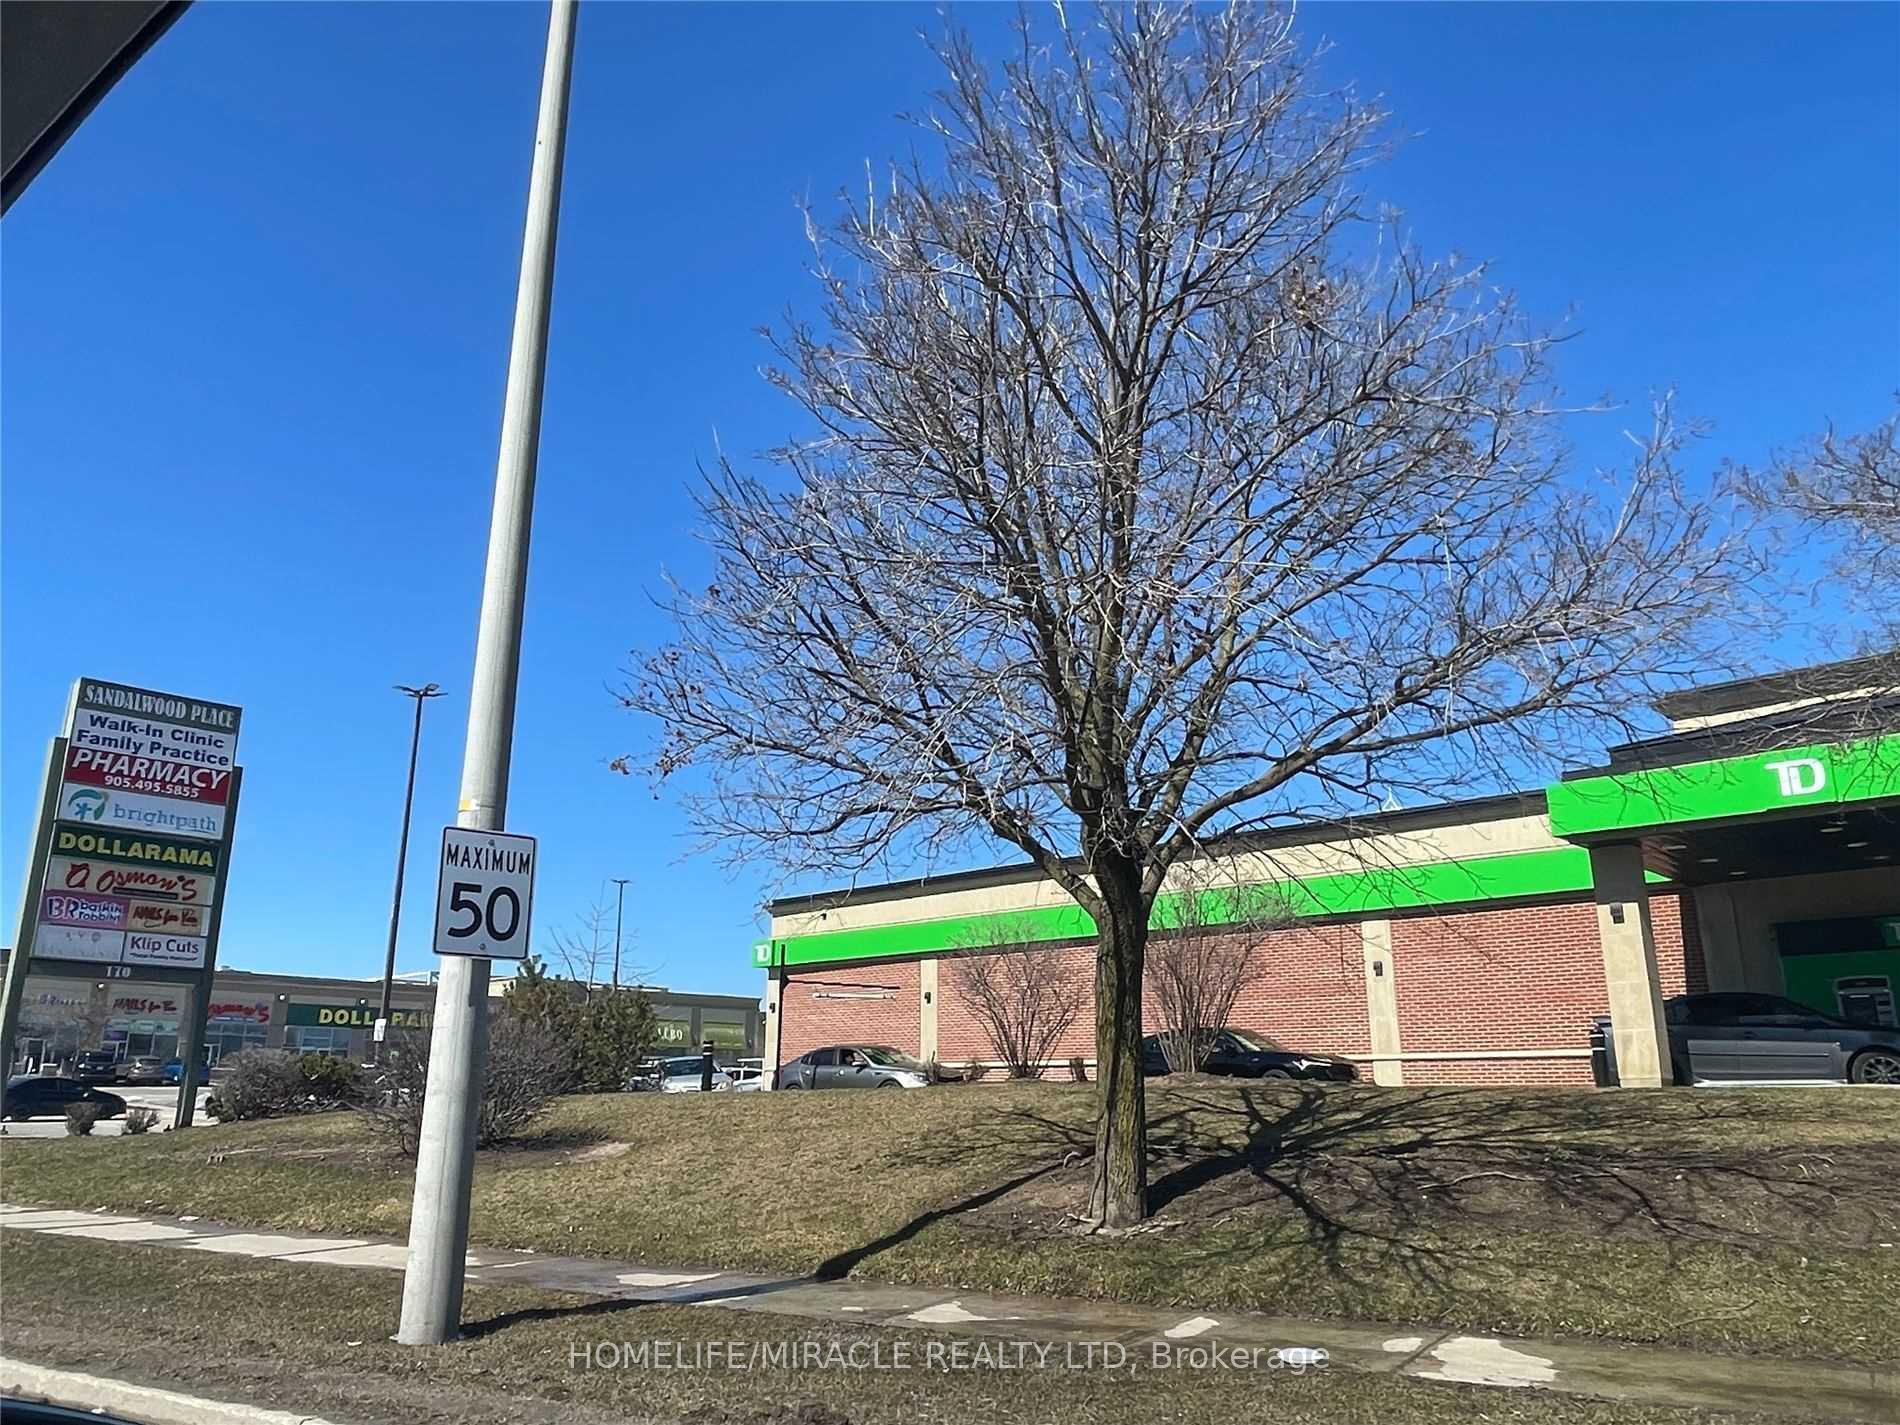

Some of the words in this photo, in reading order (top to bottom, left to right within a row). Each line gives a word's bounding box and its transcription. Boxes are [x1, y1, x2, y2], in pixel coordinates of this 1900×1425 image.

[84, 685, 187, 719] SANDALWOOD
[191, 704, 235, 728] PLACE
[77, 729, 143, 754] Family
[149, 742, 229, 766] Practice
[89, 714, 163, 738] Walk-In
[171, 729, 225, 748] Clinic
[72, 748, 228, 789] PHARMACY
[1764, 758, 1826, 797] TD
[104, 775, 200, 798] 905.495.5855
[113, 803, 216, 833] brightpath
[59, 832, 214, 867] DOLLARAMA
[446, 843, 530, 875] MAXIMUM
[447, 882, 520, 941] 50
[130, 936, 161, 953] Klip
[166, 939, 199, 954] Cuts
